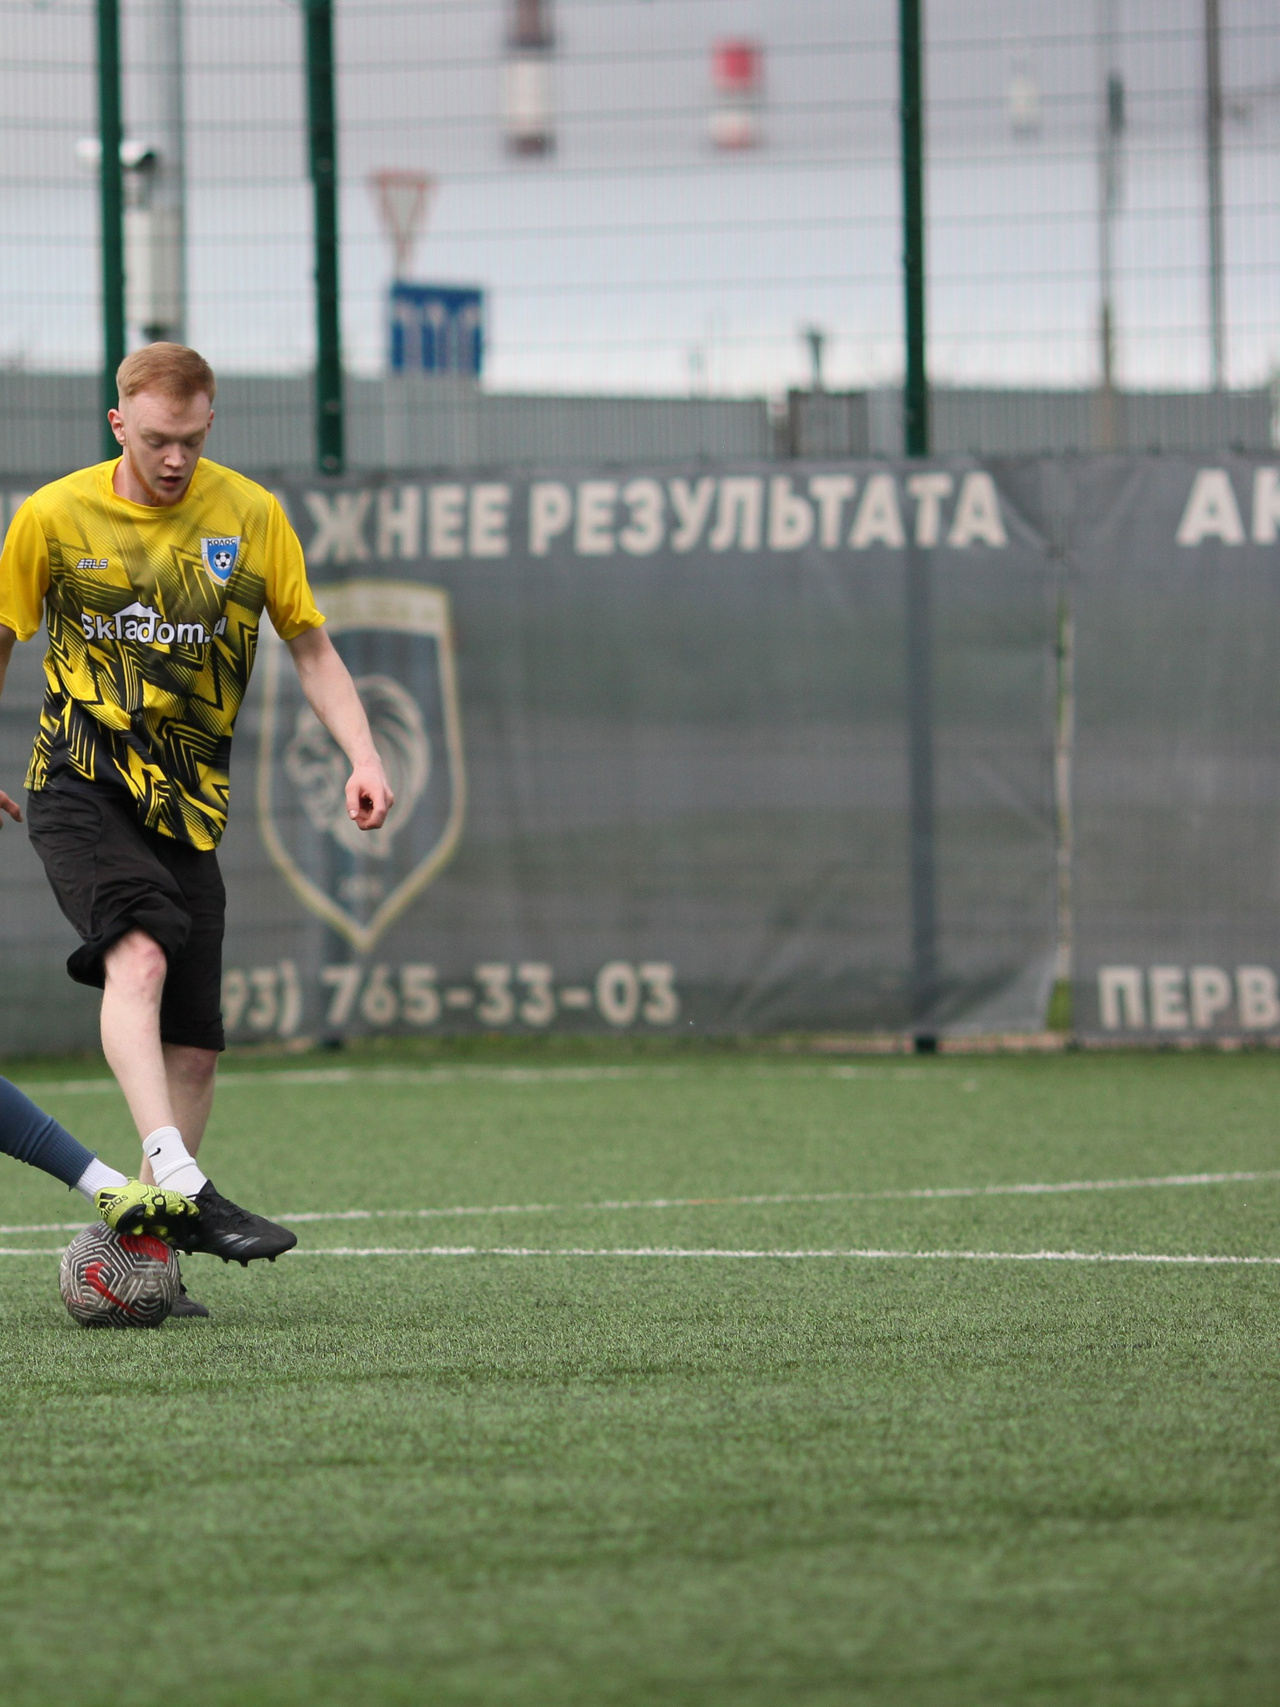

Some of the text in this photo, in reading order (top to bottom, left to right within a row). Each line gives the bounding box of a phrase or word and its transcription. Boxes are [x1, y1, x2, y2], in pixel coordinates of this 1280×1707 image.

[207, 538, 236, 546] КОЛОС
[273, 483, 511, 567] ЖНЕЕ
[528, 471, 1008, 557] РЕЗУЛЬТАТА
[323, 961, 679, 1027] 765-33-03
[1099, 965, 1280, 1029] ПЕРВ
[102, 1194, 128, 1220] didas
